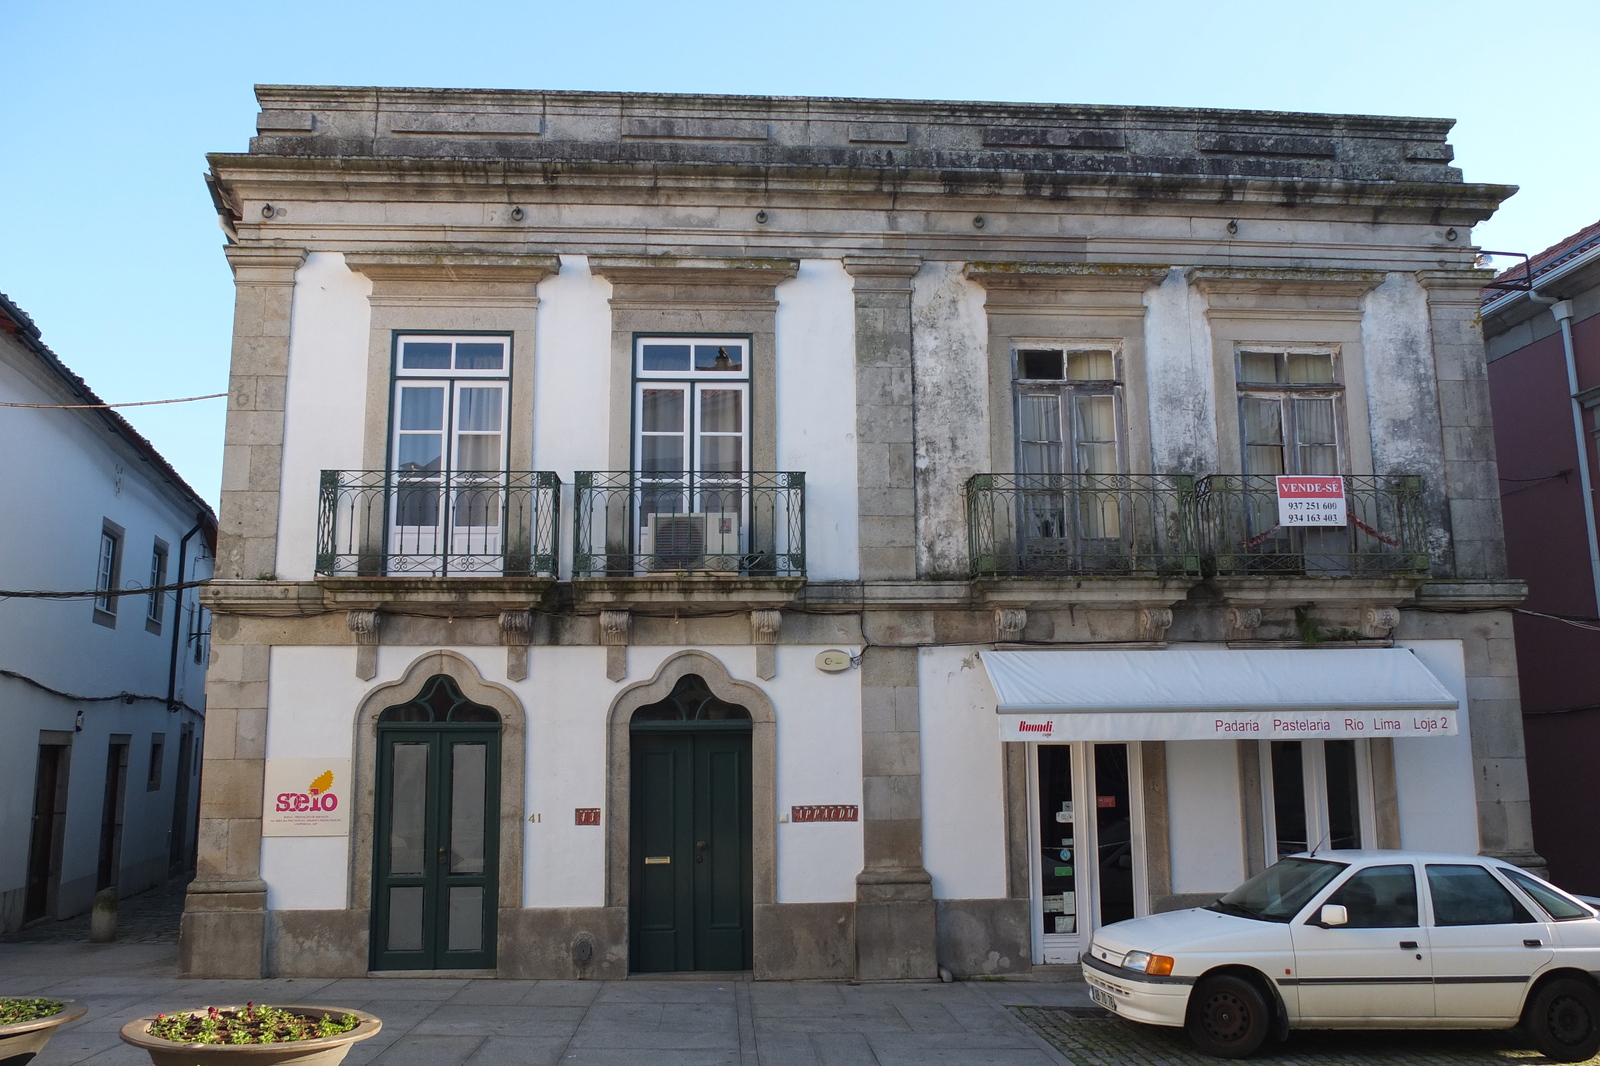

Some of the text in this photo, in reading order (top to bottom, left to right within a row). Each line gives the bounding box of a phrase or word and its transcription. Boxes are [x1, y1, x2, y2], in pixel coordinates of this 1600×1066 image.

[1288, 502, 1337, 510] 937 251 600
[1288, 514, 1338, 524] 934 163 403
[1019, 720, 1053, 732] Buondi
[1215, 716, 1449, 733] Padaria Pastelaria Rio Lima Loja 2
[528, 813, 542, 823] 41
